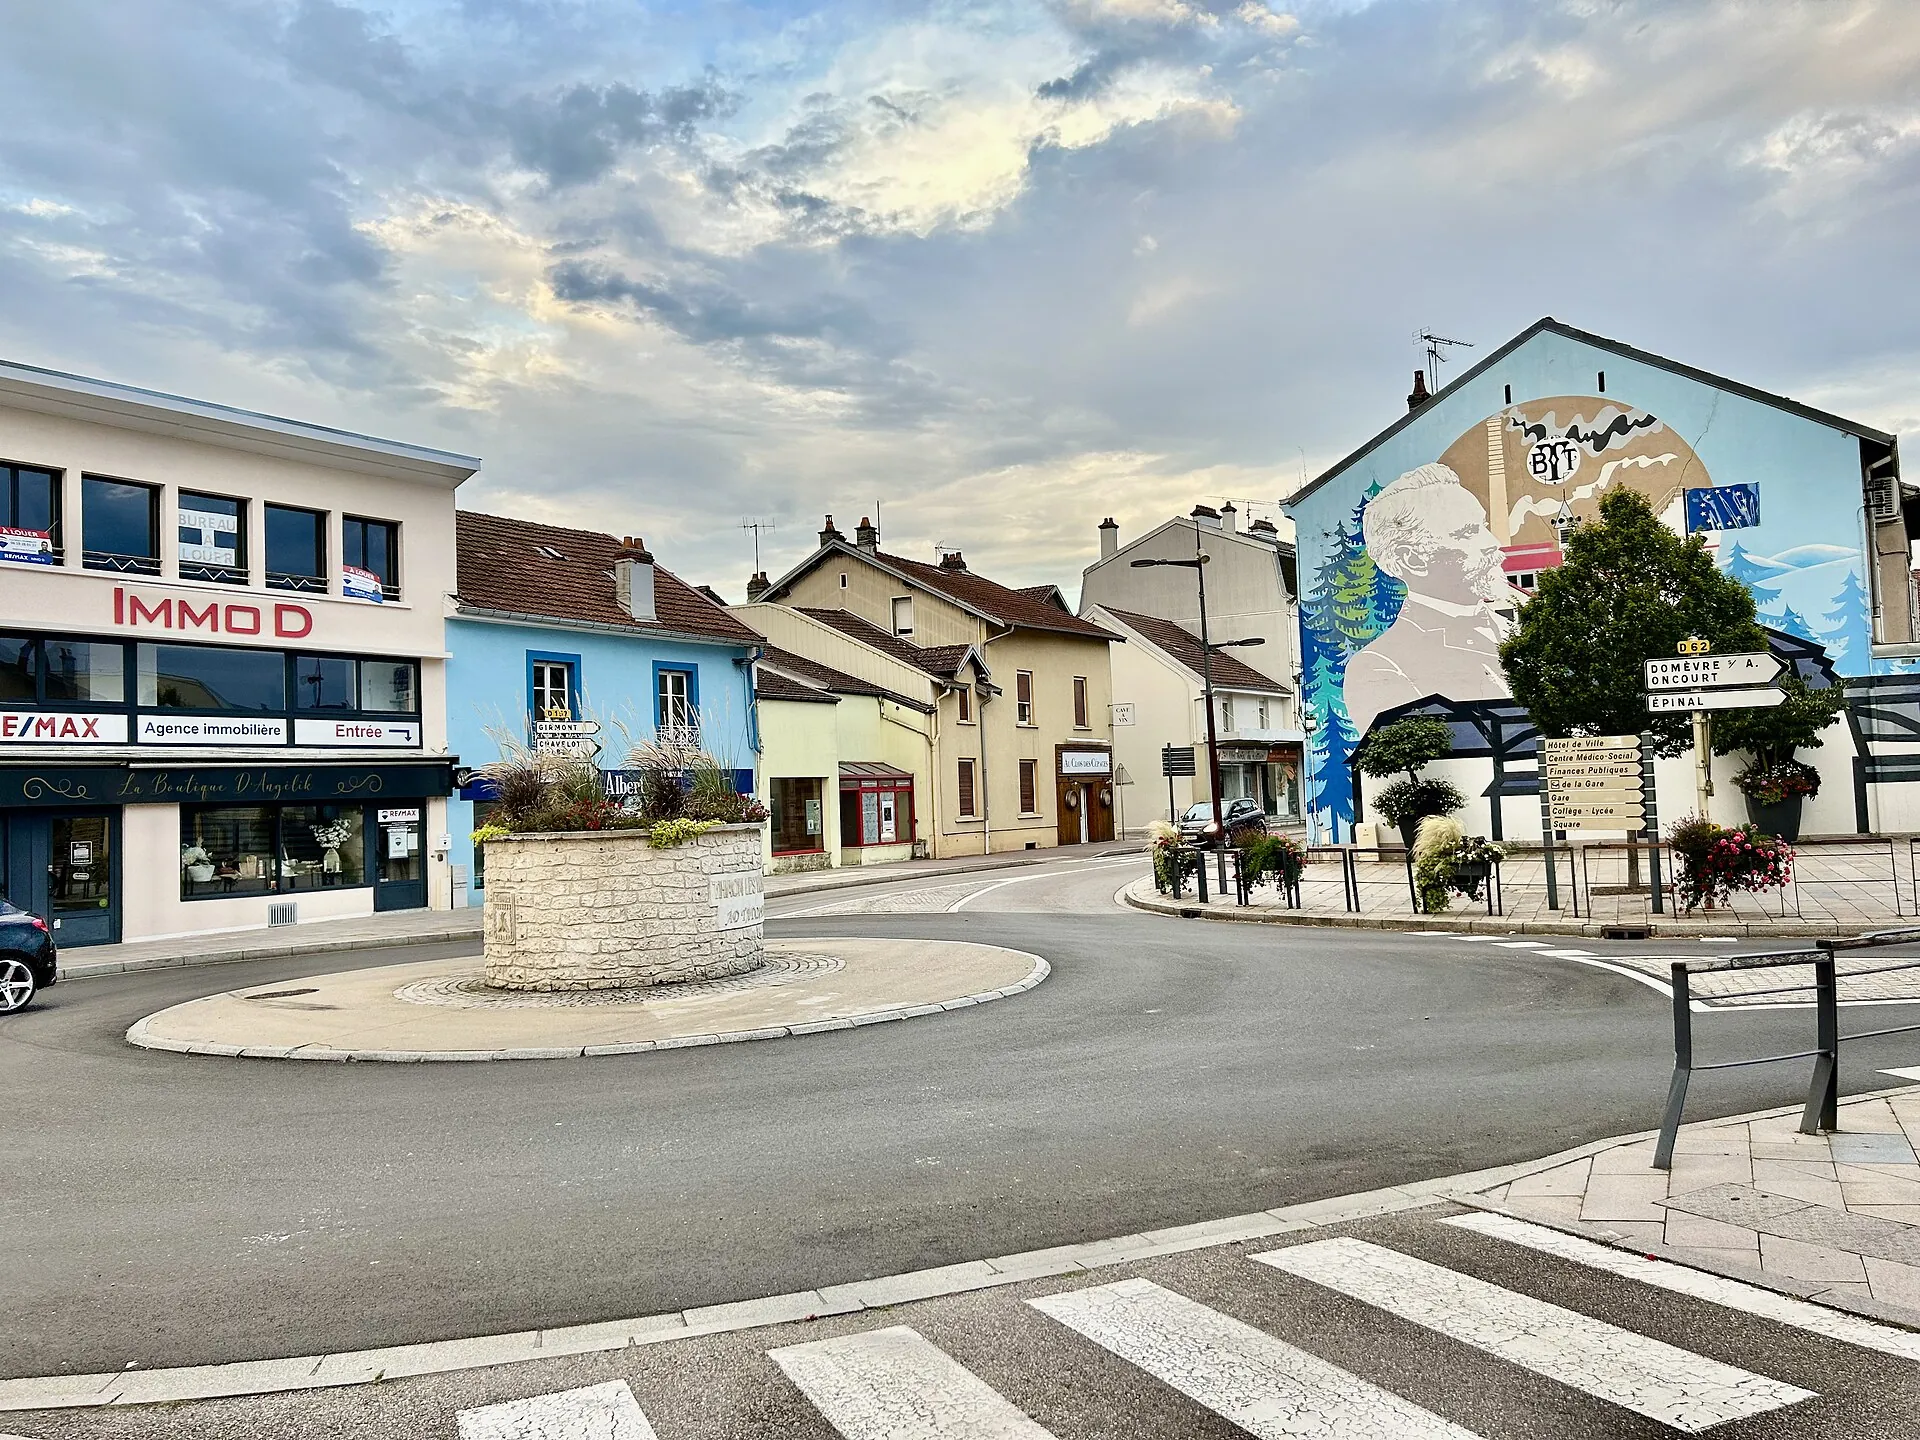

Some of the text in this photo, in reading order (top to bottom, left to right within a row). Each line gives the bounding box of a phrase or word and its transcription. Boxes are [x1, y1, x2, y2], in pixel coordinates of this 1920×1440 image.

[178, 513, 236, 532] BUREAU
[10, 529, 39, 538] LOUER
[182, 548, 234, 565] LOUER
[355, 569, 375, 580] LOUER
[114, 587, 313, 638] IMMO D
[1680, 642, 1708, 652] D 62
[1651, 660, 1720, 674] DOMÈVRE
[1651, 673, 1718, 685] ONCOURT
[1652, 697, 1704, 708] ÉPINAL
[145, 722, 281, 737] Agence immobilière
[336, 724, 383, 738] Entrée
[539, 740, 580, 748] CHAVELOT
[1547, 741, 1569, 749] Hôtel
[1585, 739, 1604, 747] Ville
[1548, 751, 1633, 762] Centre Médico-Social
[1549, 766, 1629, 775] Finances Publiques
[117, 772, 143, 796] La
[152, 774, 227, 800] Boutique
[1574, 780, 1582, 788] la
[1585, 780, 1604, 788] Gare
[1551, 794, 1570, 802] Gare
[1552, 807, 1582, 816] Collège
[1591, 806, 1614, 816] Lycée
[1553, 820, 1581, 829] Square
